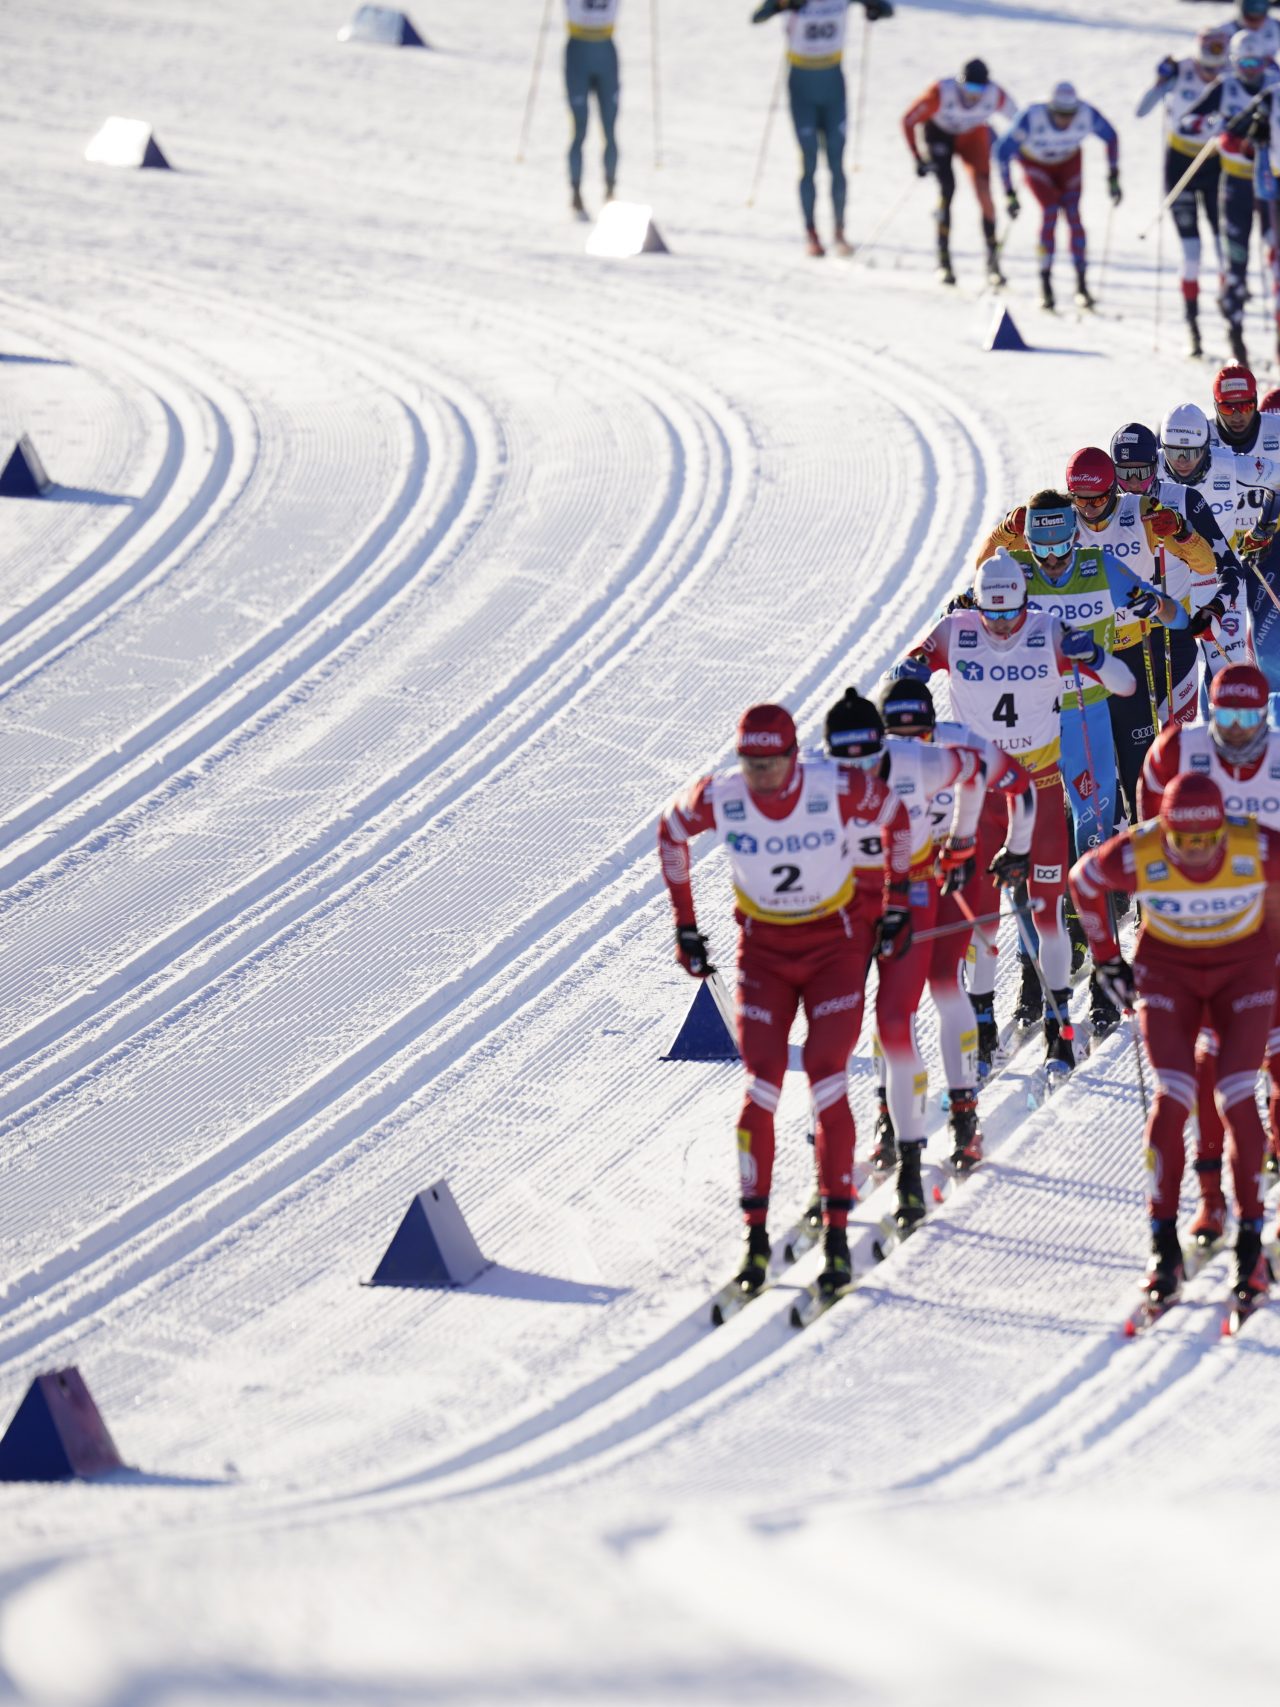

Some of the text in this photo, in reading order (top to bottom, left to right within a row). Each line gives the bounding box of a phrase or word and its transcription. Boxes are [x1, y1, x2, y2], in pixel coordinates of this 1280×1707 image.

[1103, 541, 1141, 558] BOS
[1048, 600, 1104, 619] OBOS
[989, 665, 1049, 682] OBOS
[992, 692, 1019, 728] 4
[766, 830, 837, 856] OBOS
[770, 865, 804, 893] 2
